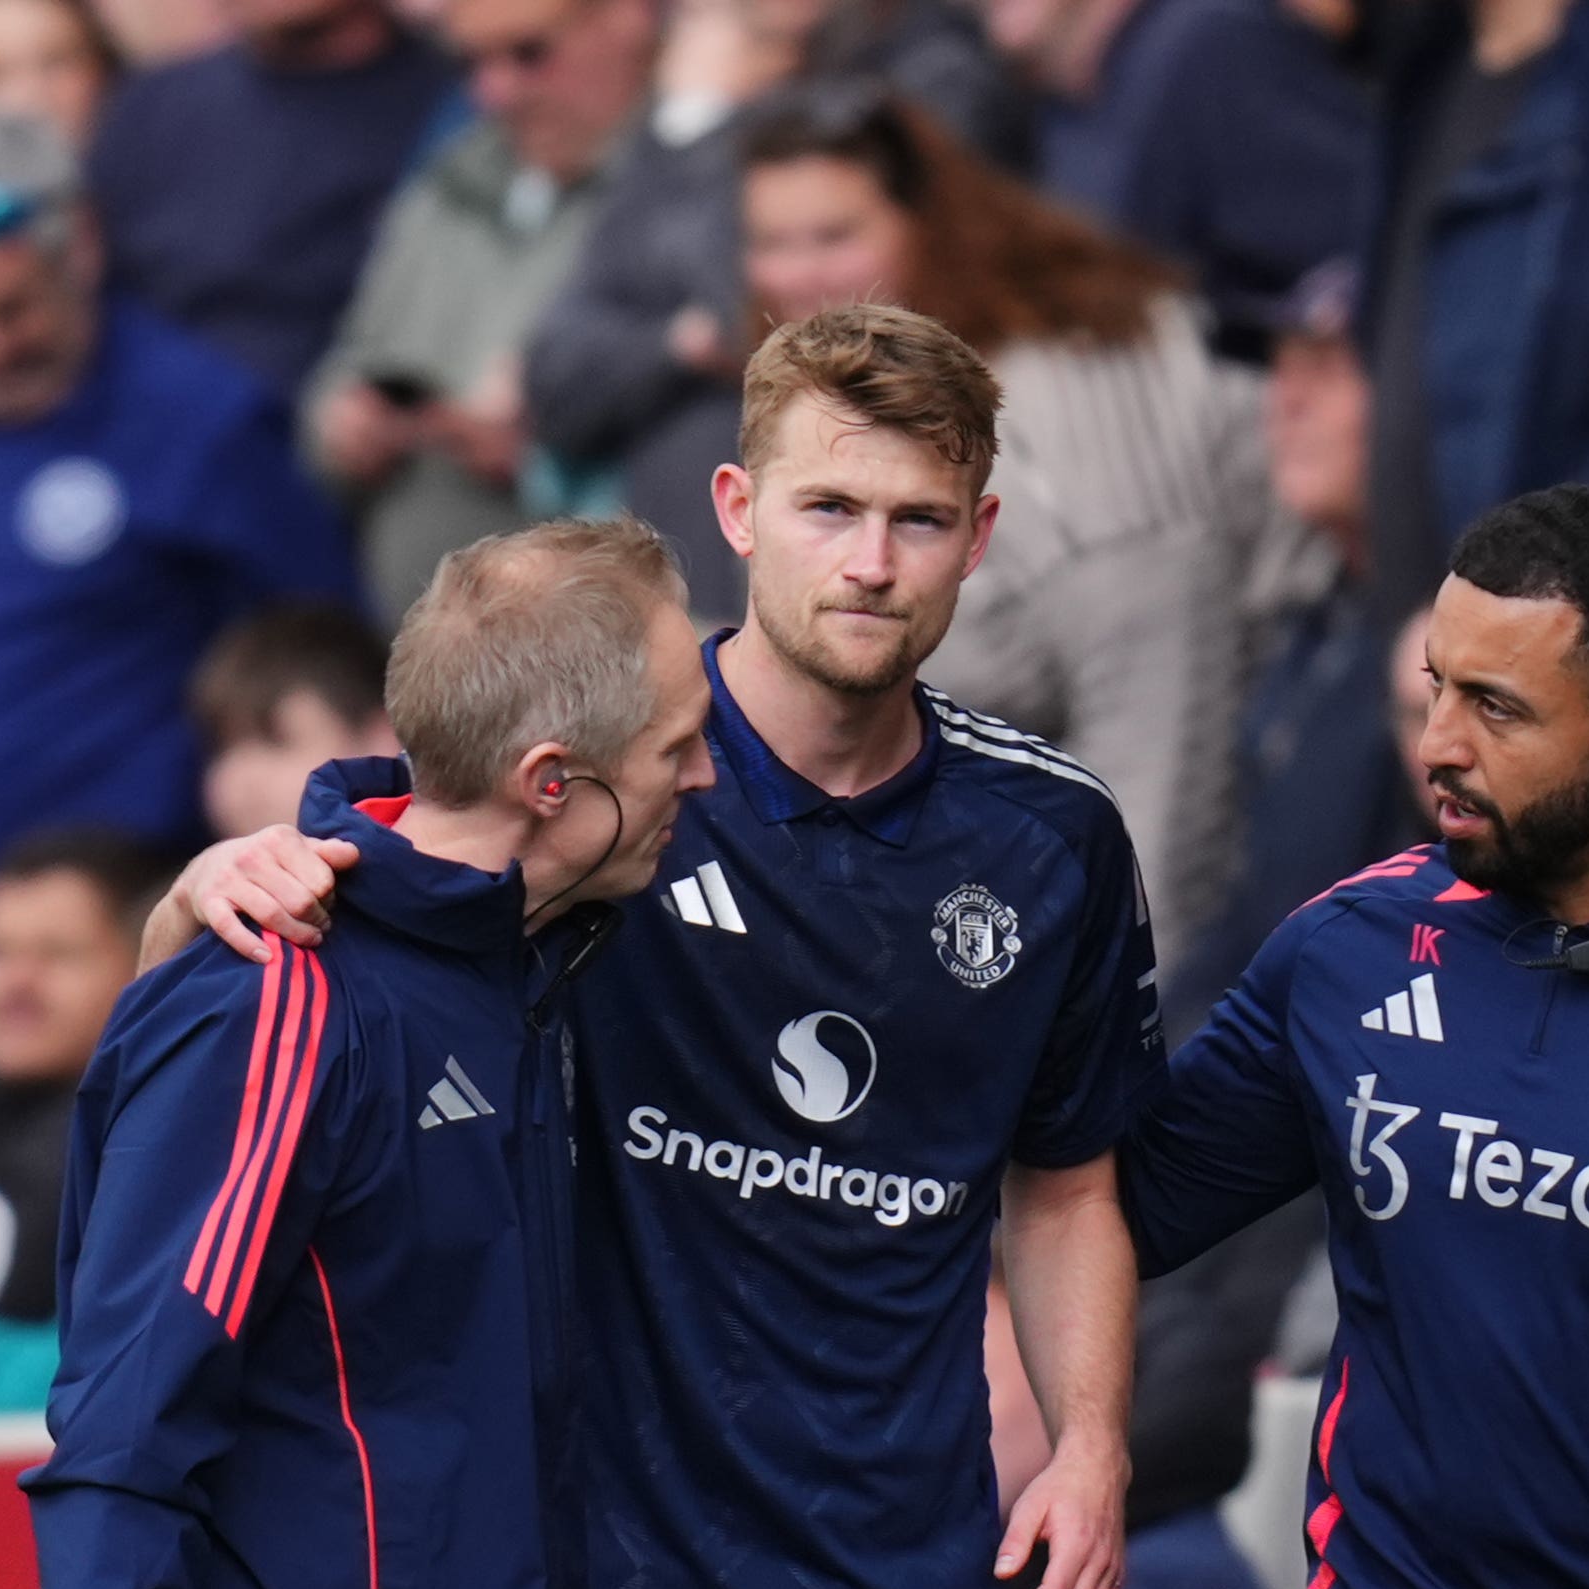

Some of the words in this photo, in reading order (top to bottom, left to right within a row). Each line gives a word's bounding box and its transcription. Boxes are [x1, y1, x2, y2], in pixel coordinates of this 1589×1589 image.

[939, 890, 1011, 929] MANCHESTER
[1409, 923, 1446, 967] IK
[950, 960, 1001, 981] UNITED
[622, 1105, 969, 1227] Snapdragon
